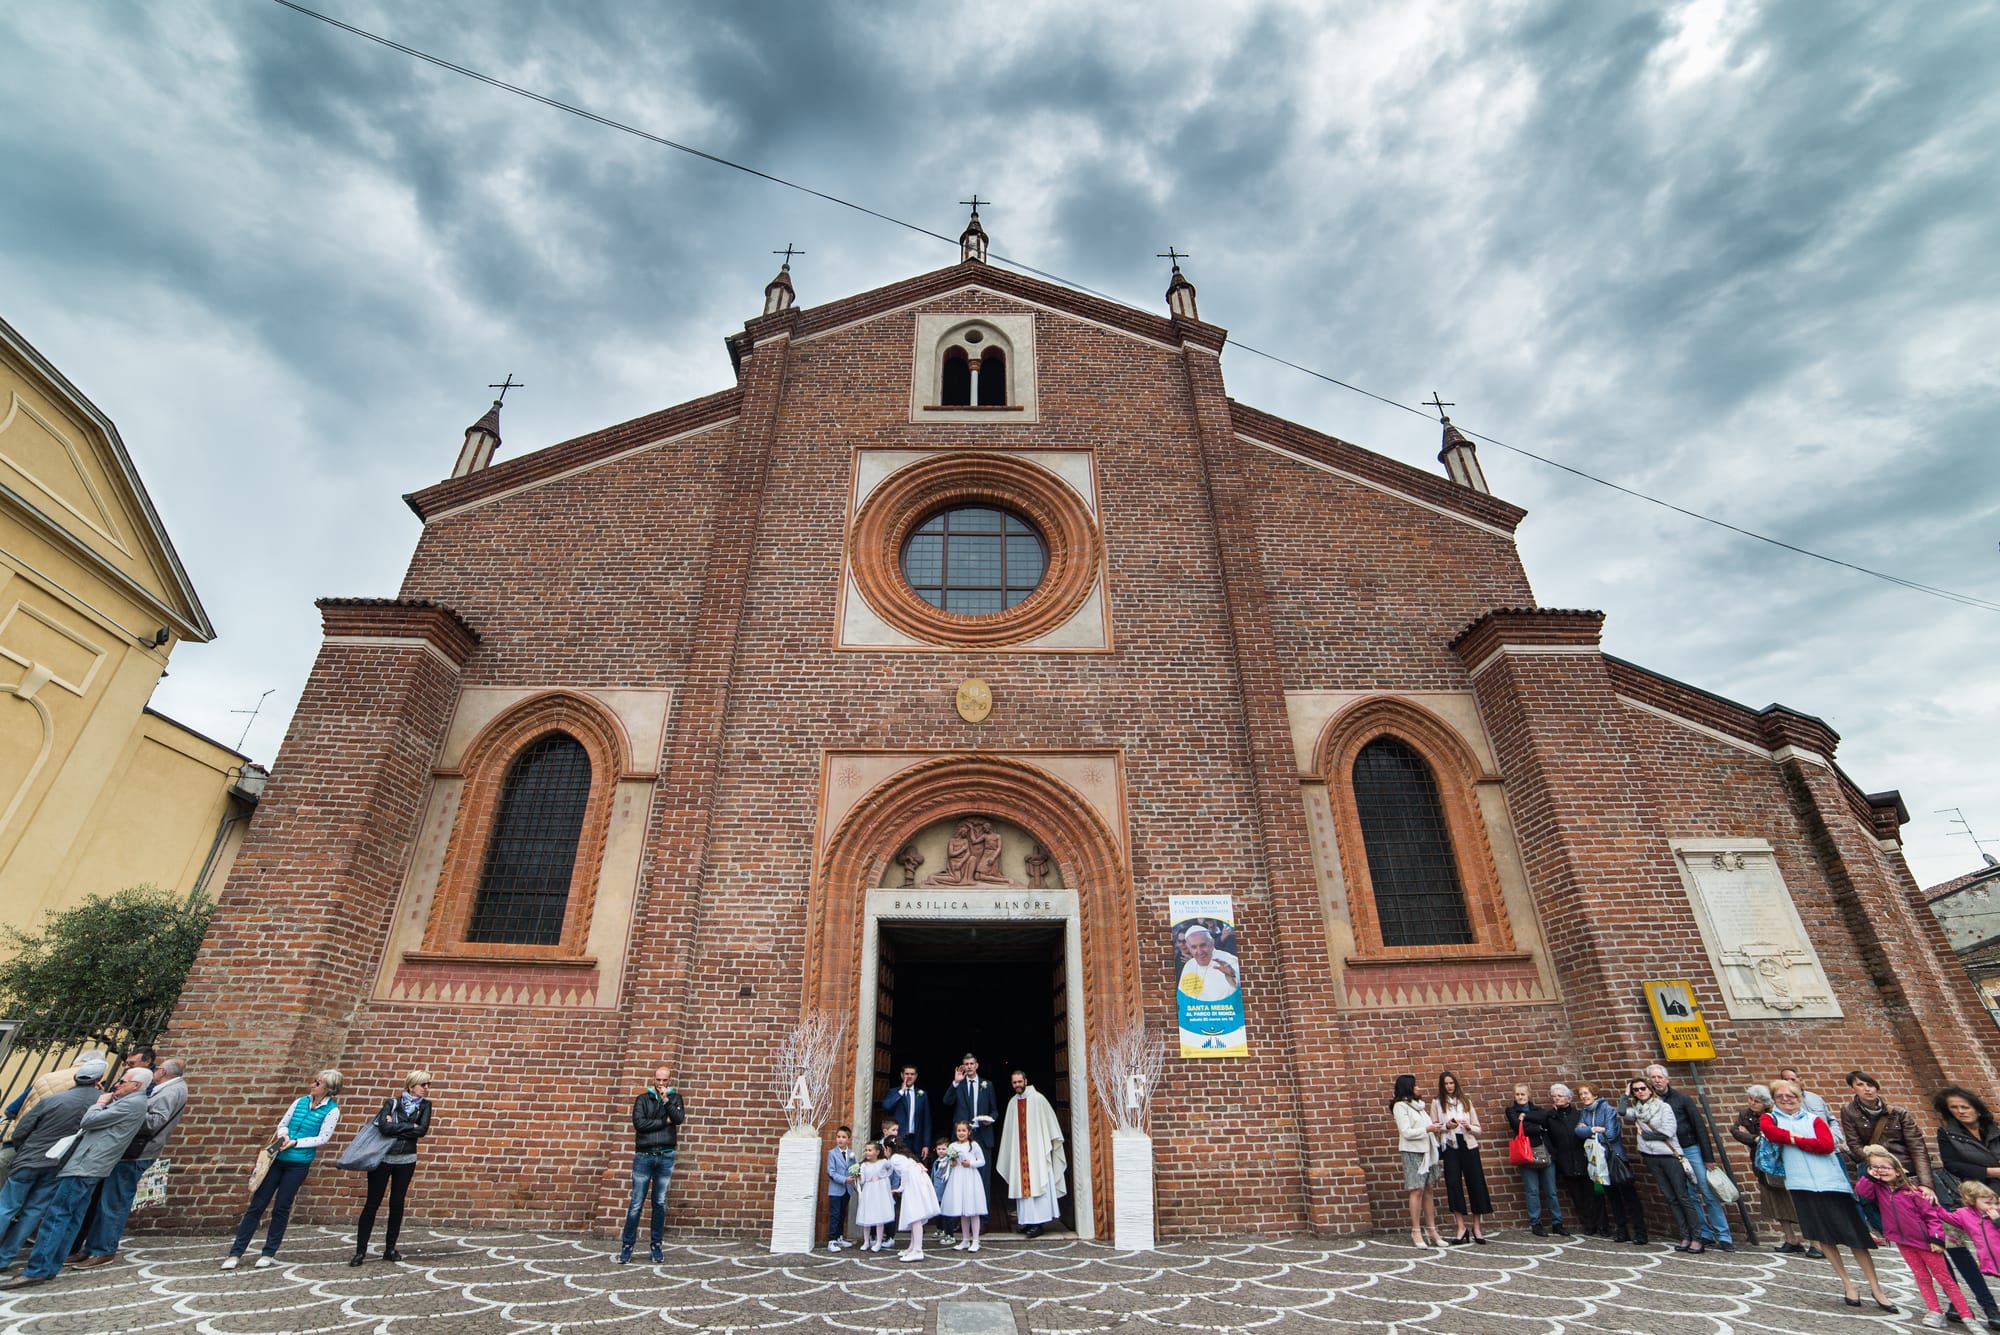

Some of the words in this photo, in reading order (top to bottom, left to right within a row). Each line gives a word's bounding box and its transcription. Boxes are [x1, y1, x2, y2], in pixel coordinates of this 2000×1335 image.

[895, 901, 969, 909] BASILICA
[994, 901, 1051, 909] MINORE
[784, 1075, 814, 1110] A
